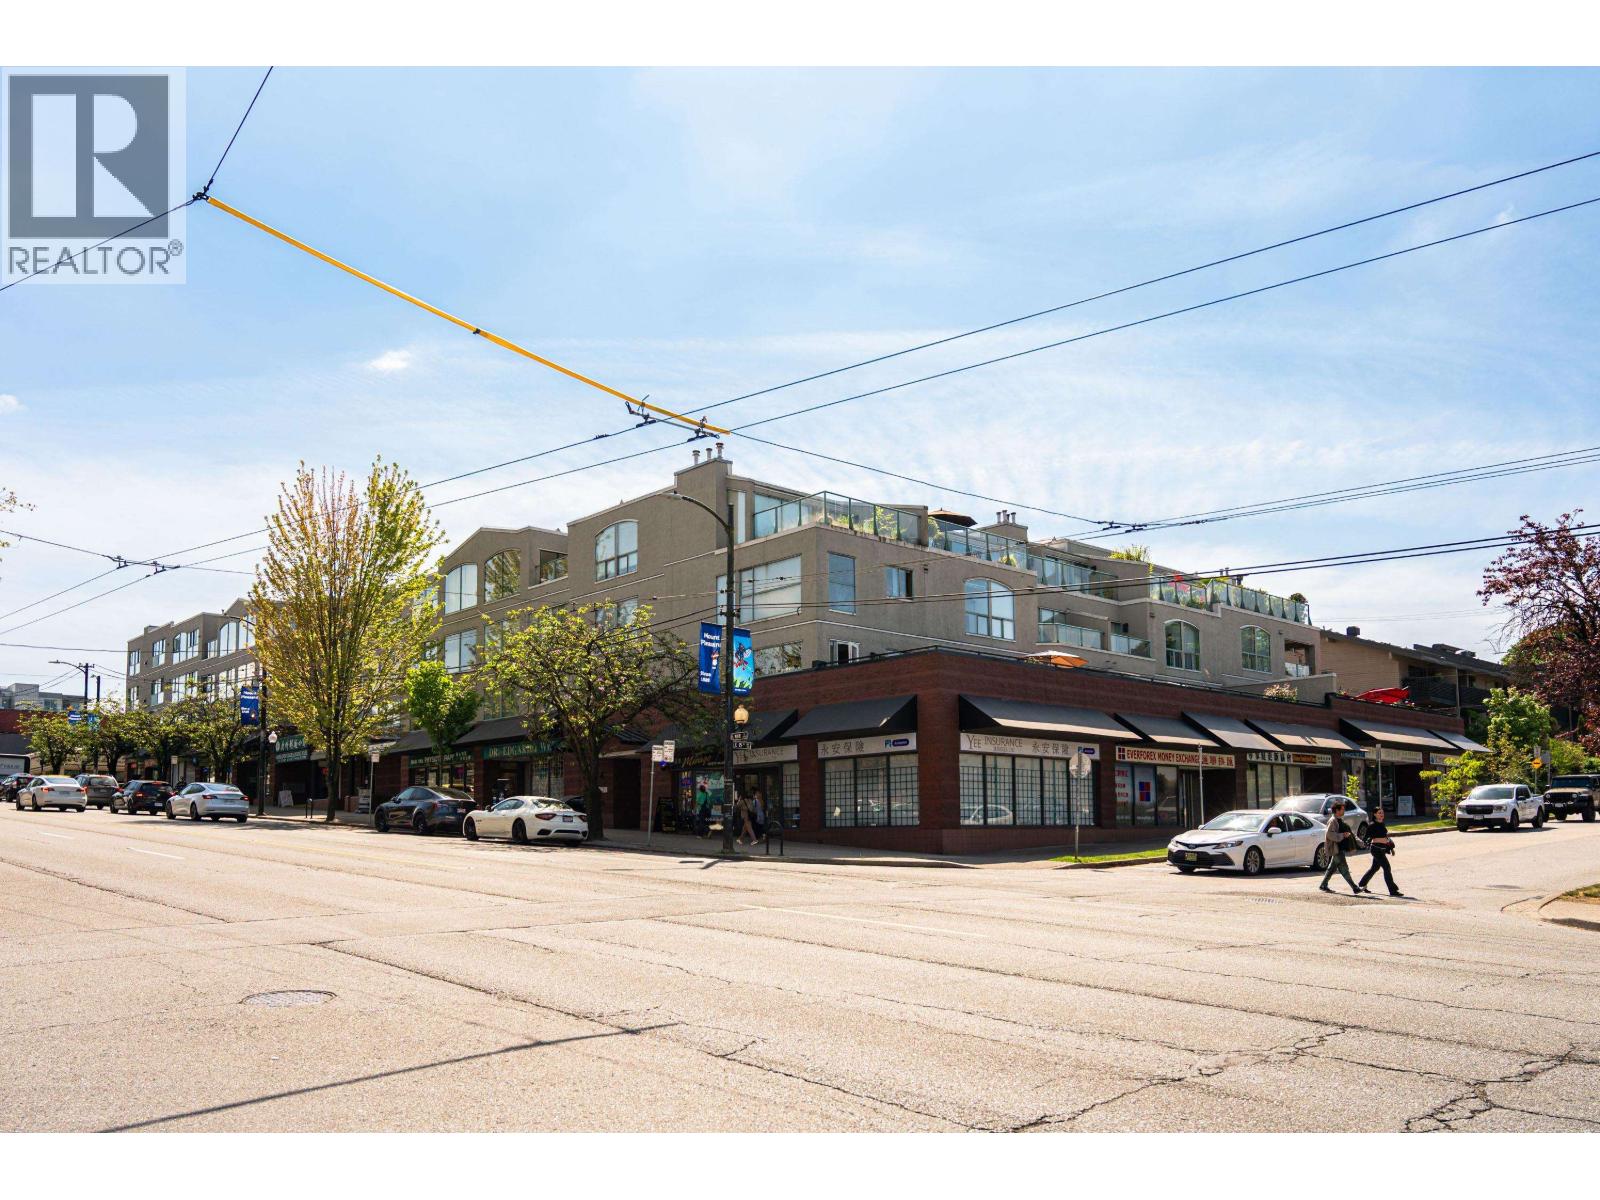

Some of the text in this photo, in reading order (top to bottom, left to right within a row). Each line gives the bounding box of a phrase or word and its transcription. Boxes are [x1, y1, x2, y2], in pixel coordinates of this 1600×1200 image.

[984, 736, 1023, 748] INSURANCE
[1126, 749, 1157, 760] EVERFOREX
[1157, 751, 1175, 762] MONEY
